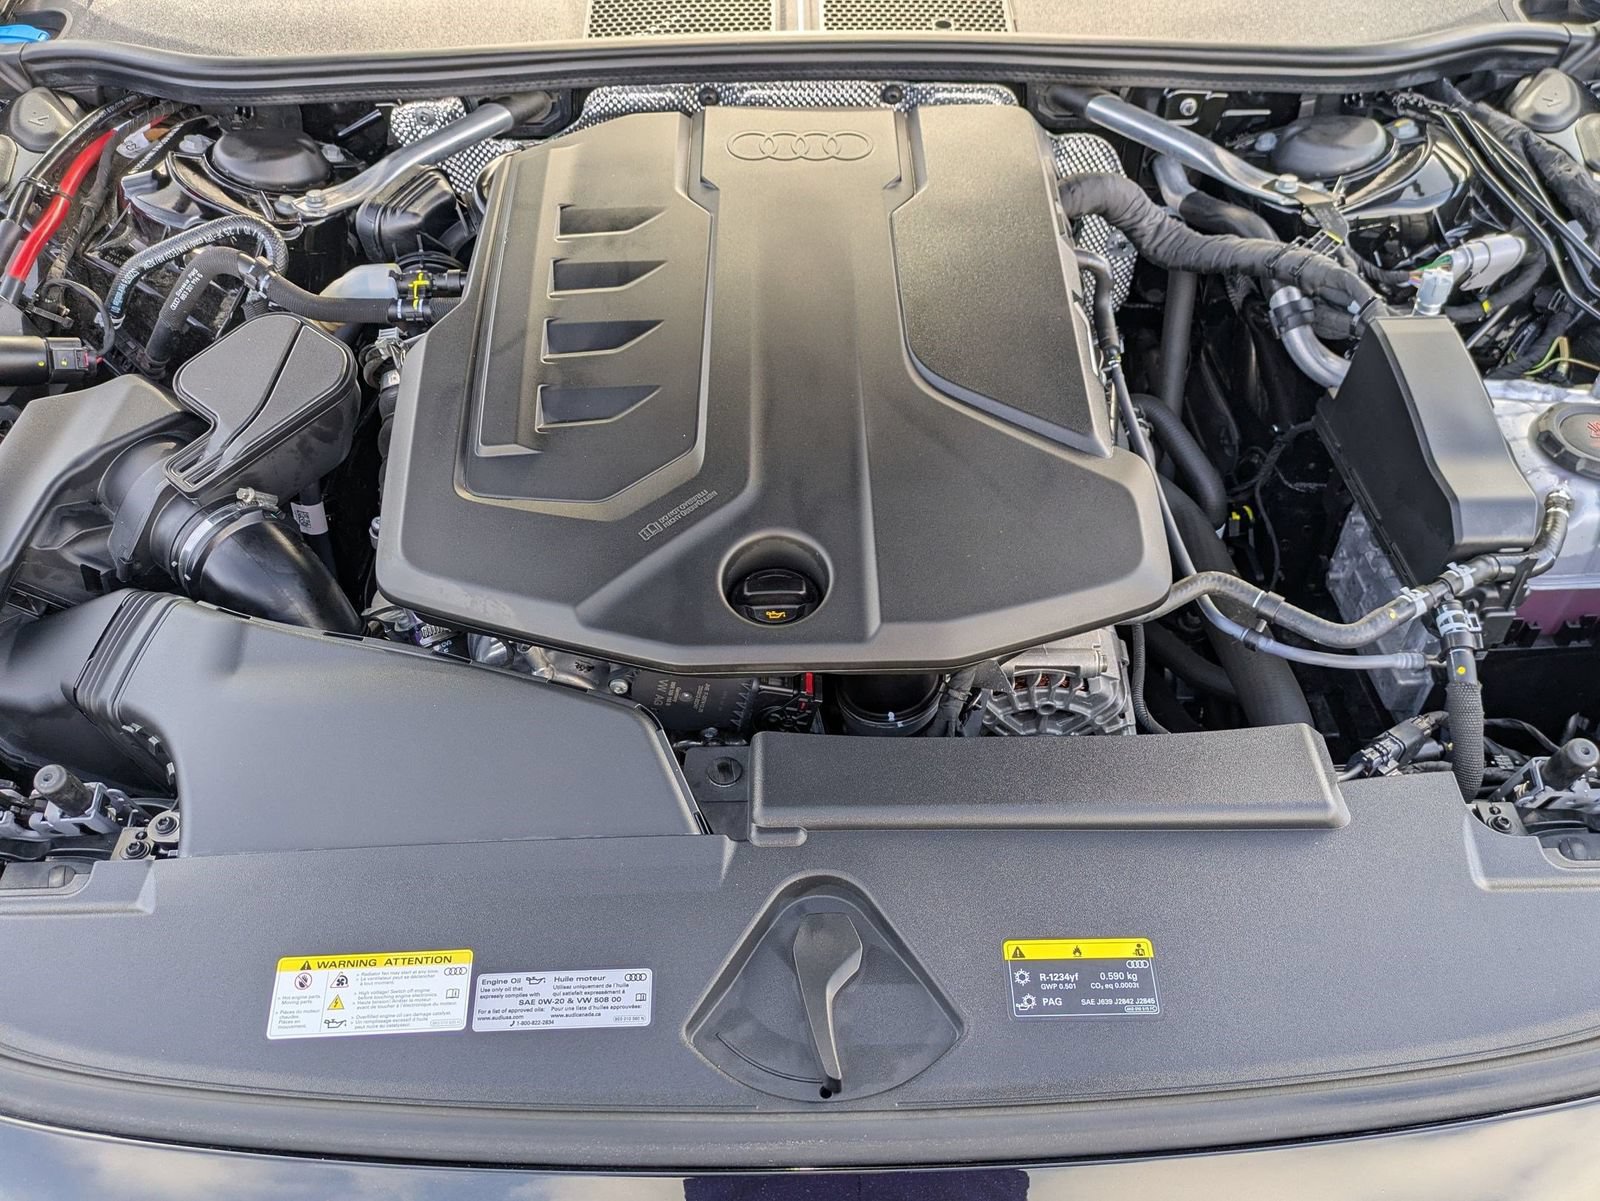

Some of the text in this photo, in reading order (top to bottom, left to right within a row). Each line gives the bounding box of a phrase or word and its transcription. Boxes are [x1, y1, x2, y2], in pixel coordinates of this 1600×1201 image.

[653, 679, 669, 706] VW AG
[317, 956, 452, 969] WARNING ATTENTION
[554, 975, 574, 983] Huile
[1039, 972, 1079, 982] R-1234yf
[1100, 971, 1138, 982] 0.590 kg
[1042, 998, 1063, 1006] PAG
[1081, 998, 1096, 1006] SAE
[1136, 997, 1156, 1005] J2845
